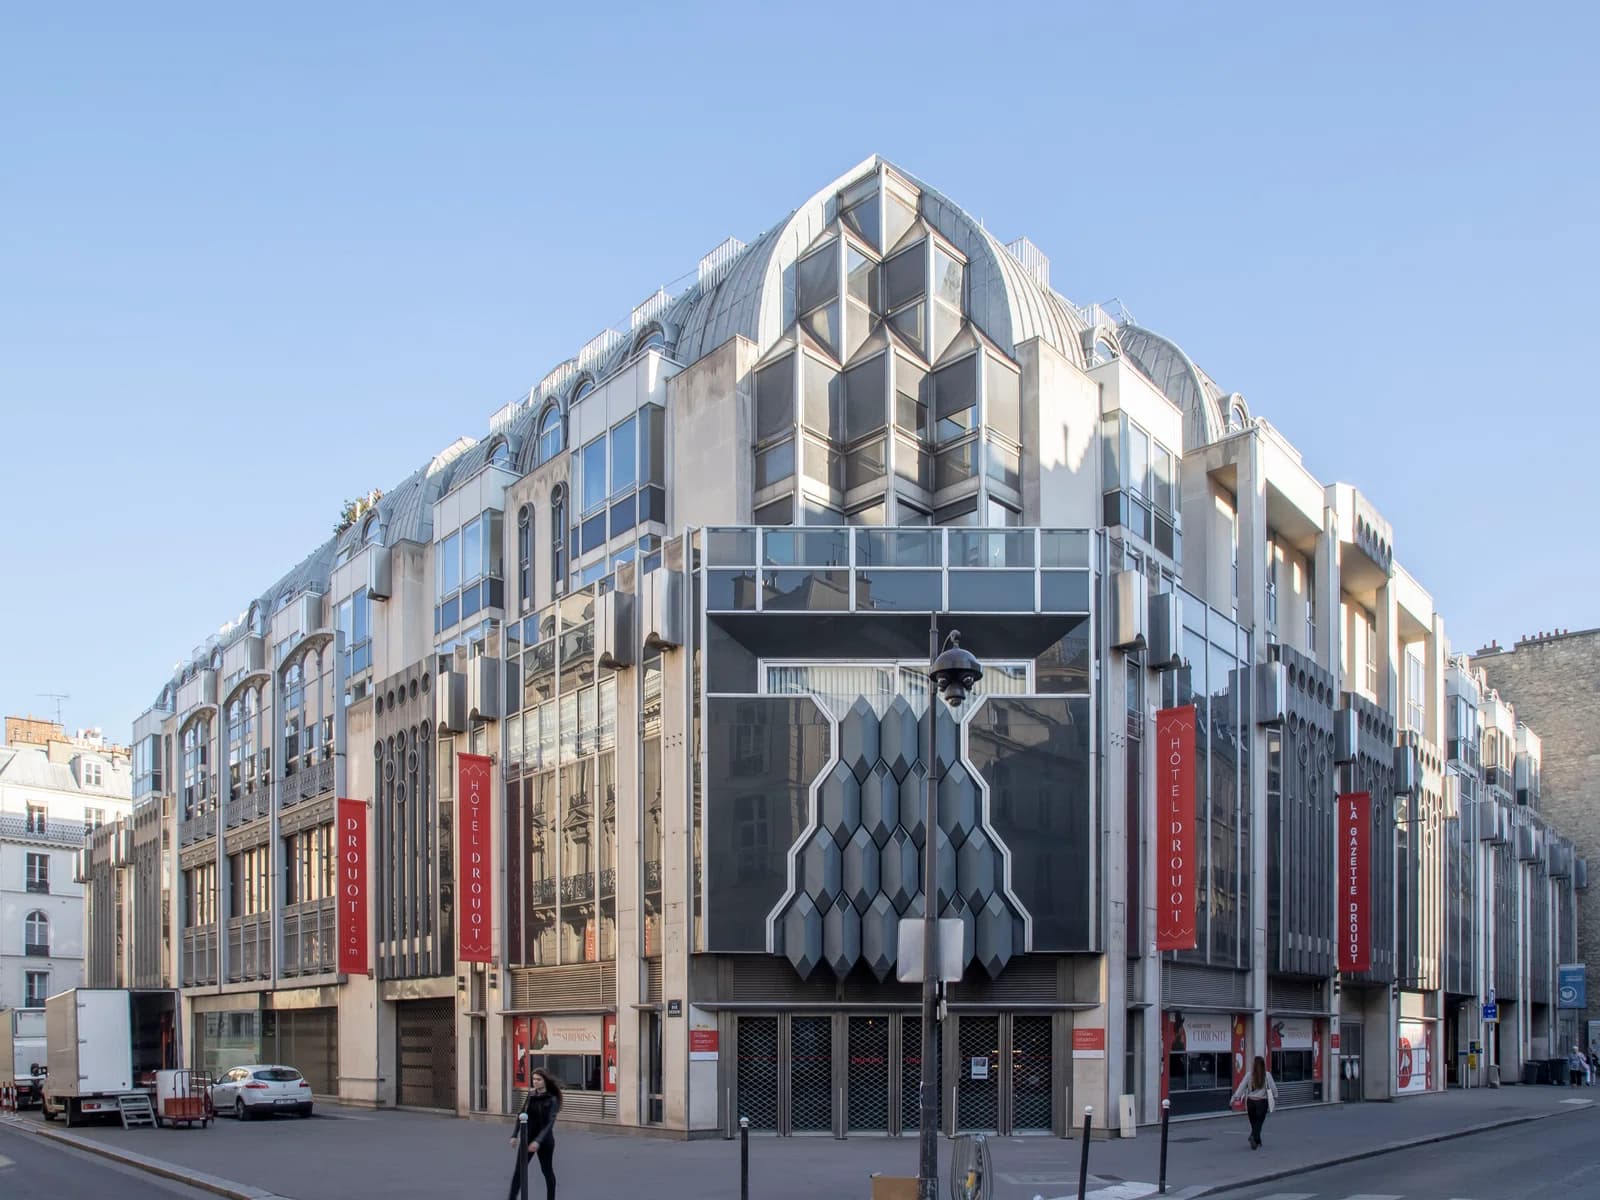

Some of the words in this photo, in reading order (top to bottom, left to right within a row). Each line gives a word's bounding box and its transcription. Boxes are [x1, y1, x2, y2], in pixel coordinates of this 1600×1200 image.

[1170, 738, 1181, 812] HÔTEL
[470, 781, 480, 845] HÔTEL
[1350, 801, 1358, 819] LA
[1171, 821, 1182, 922] DROUOT
[1350, 828, 1358, 895] GAZETTE
[472, 852, 481, 940] DROUOT
[1350, 903, 1358, 963] DROUOT
